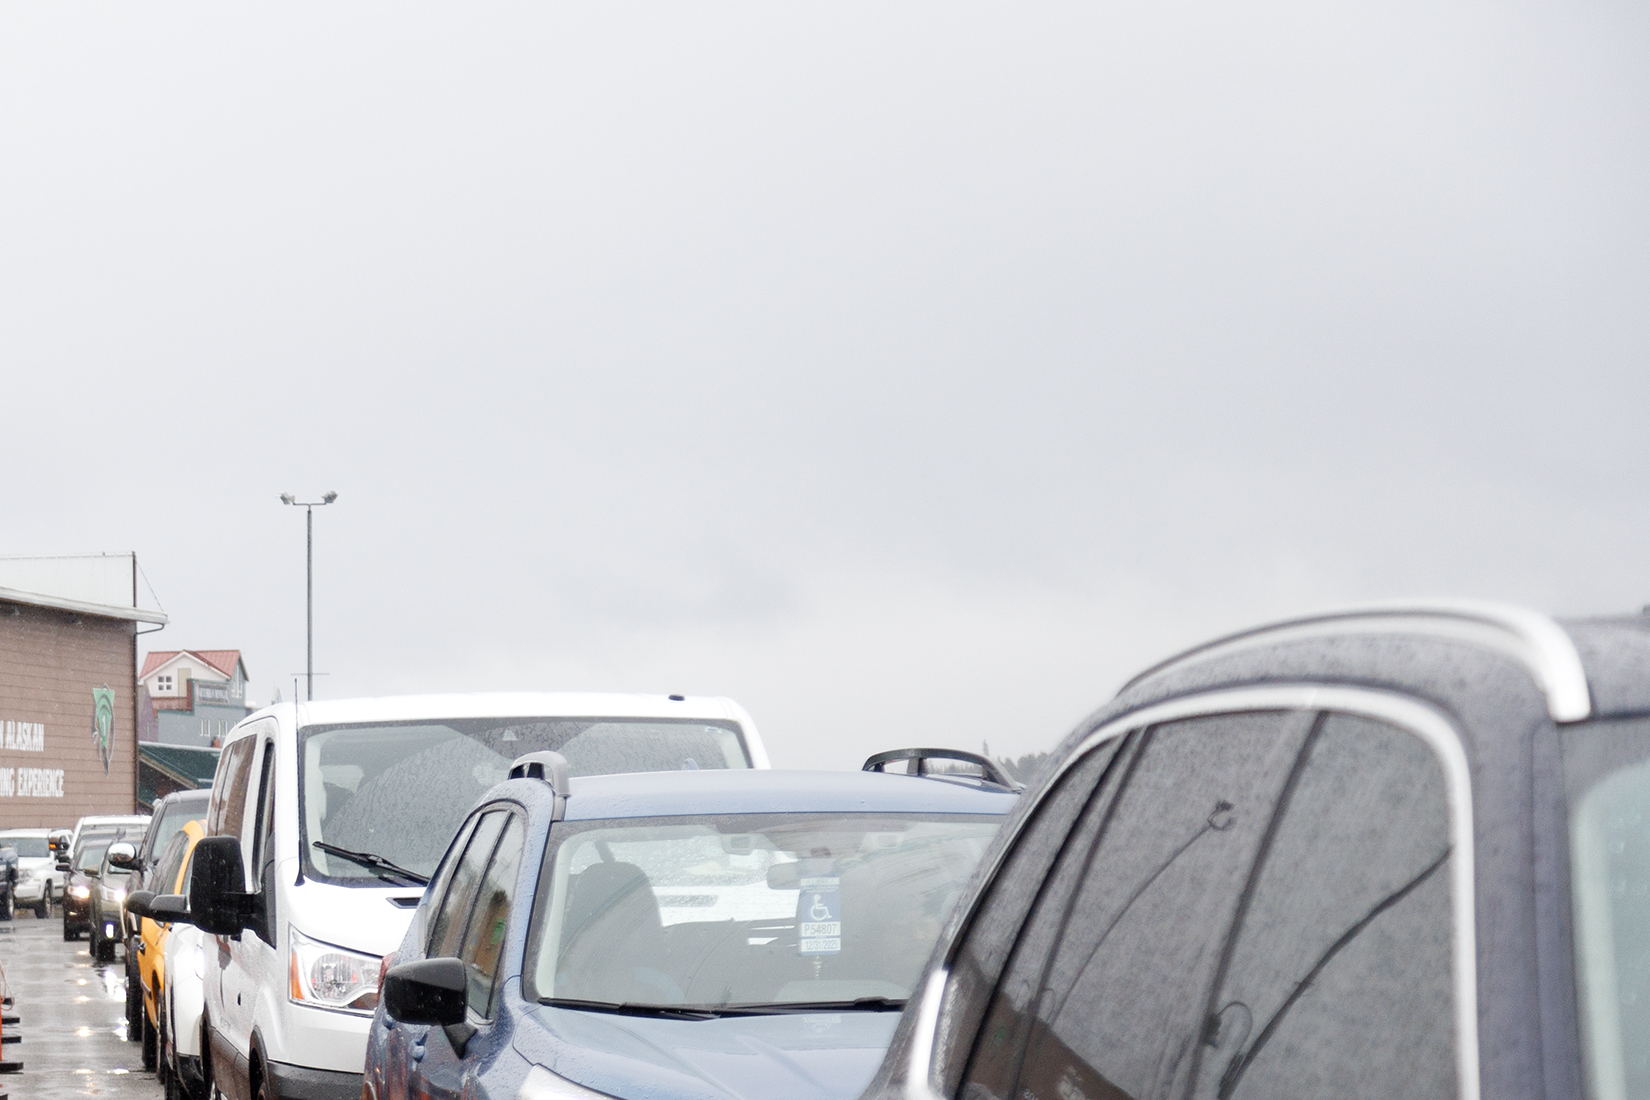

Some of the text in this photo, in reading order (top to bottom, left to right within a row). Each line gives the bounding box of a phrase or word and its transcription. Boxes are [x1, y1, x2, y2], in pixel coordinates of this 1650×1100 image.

[5, 720, 45, 752] ALASKAN
[17, 767, 65, 797] EXPERIENCE
[804, 923, 837, 935] P54807
